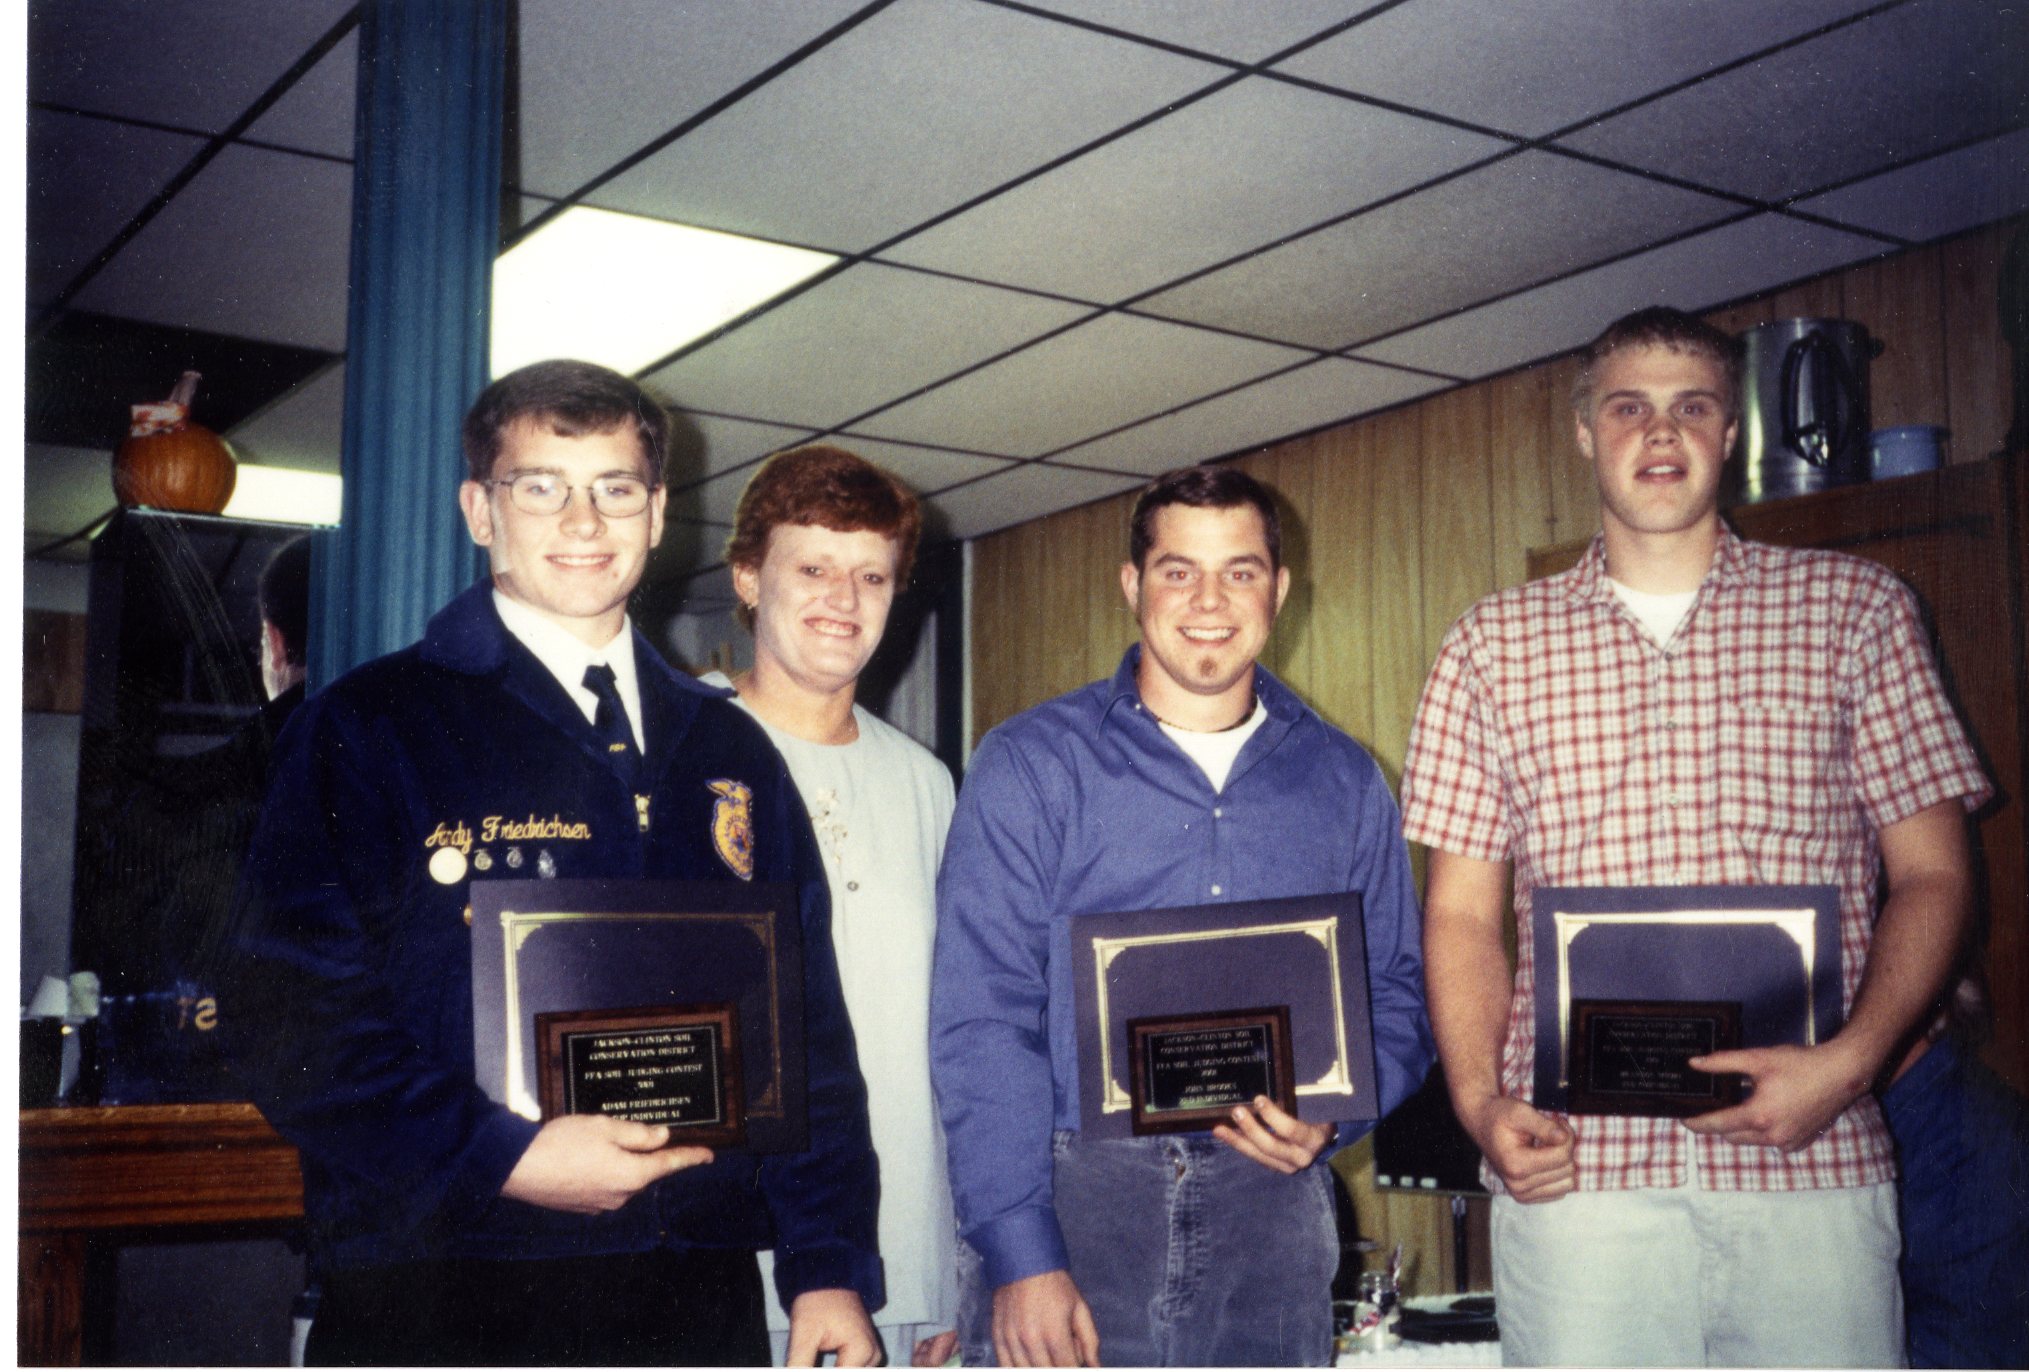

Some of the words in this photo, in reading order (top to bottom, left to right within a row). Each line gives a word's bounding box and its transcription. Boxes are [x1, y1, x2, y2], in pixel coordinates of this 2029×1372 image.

[481, 813, 591, 842] Friedrichsen
[589, 1048, 656, 1060] CONSERVATION
[658, 1046, 695, 1056] DISTRICT
[1160, 1043, 1218, 1053] CONSERVATION
[1221, 1041, 1254, 1050] DISTRICT
[604, 1069, 622, 1079] SOIL
[627, 1066, 664, 1077] JUDGING
[665, 1063, 703, 1074] CONTEST
